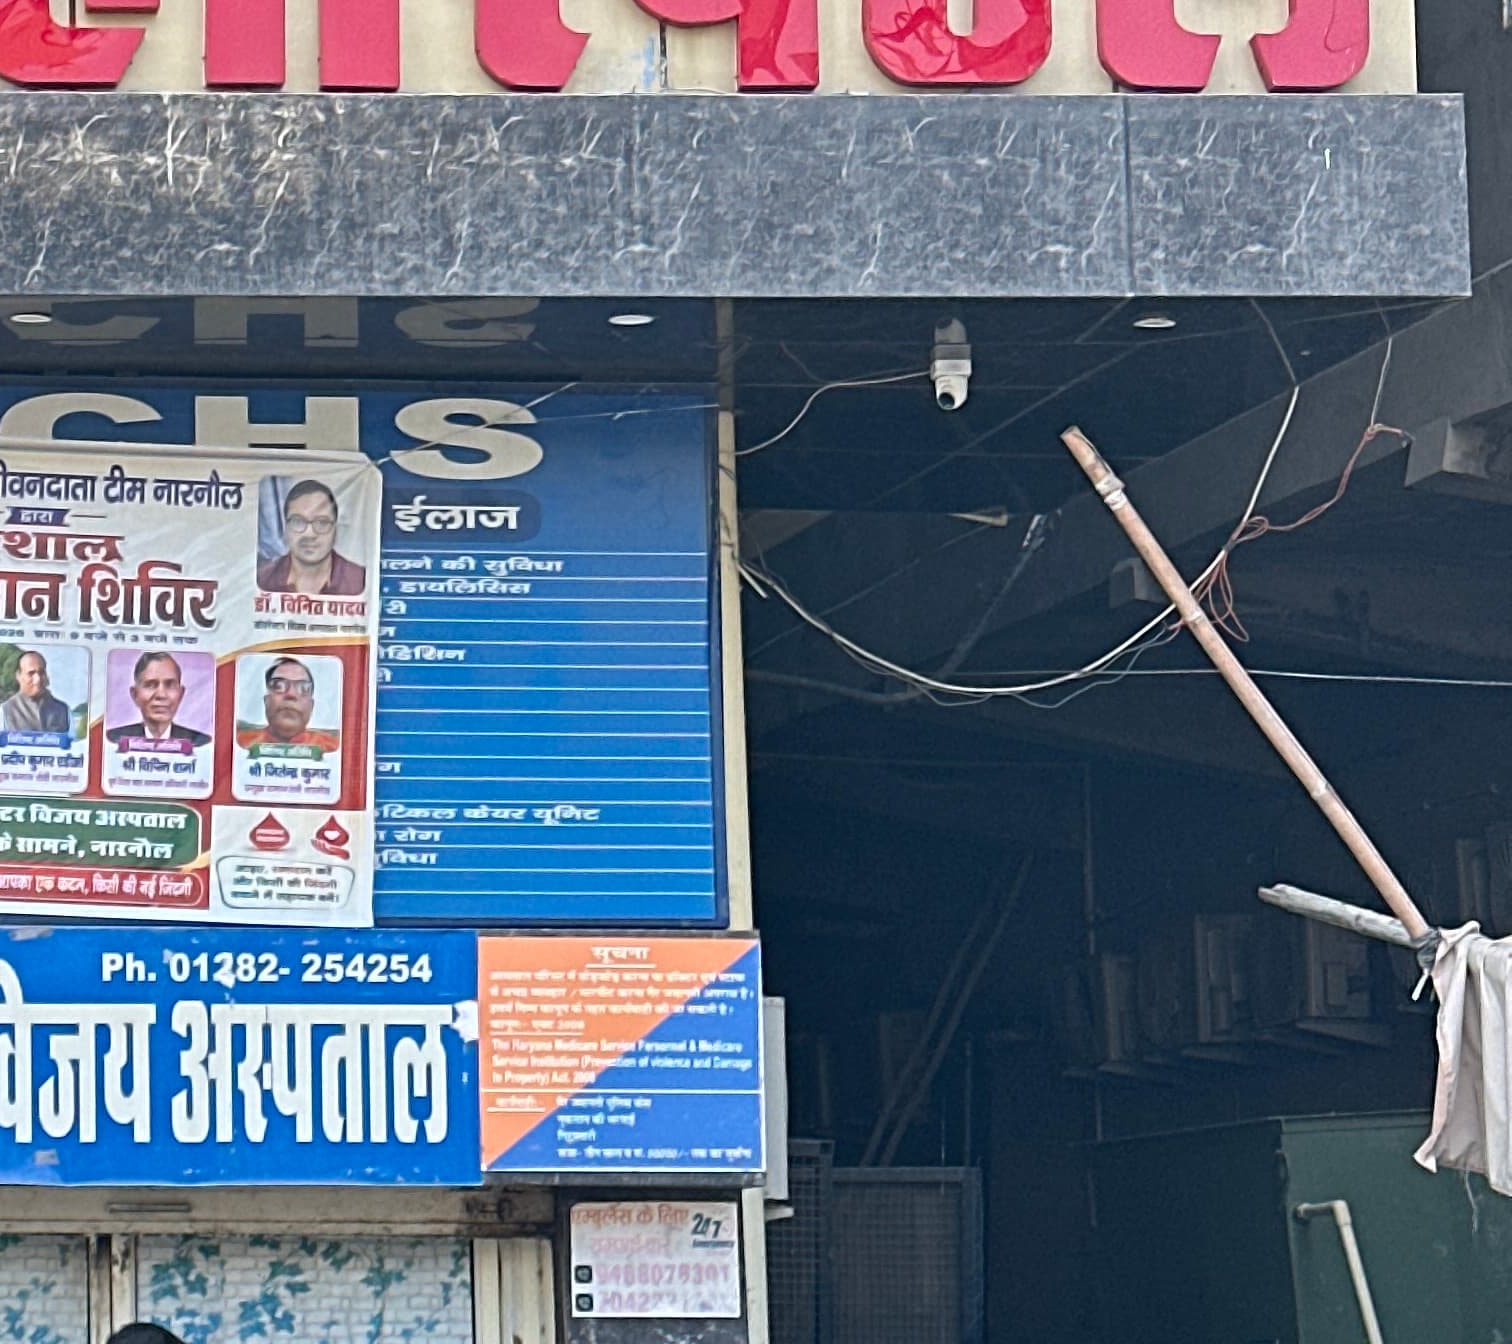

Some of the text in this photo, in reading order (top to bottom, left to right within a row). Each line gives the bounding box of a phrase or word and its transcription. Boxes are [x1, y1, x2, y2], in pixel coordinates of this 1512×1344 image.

[103, 464, 147, 504] टीम
[153, 469, 245, 509] नारनौल
[392, 495, 521, 533] ईलाज
[441, 556, 477, 571] की
[483, 556, 564, 577] सुविधा
[77, 560, 219, 629] शिविर
[399, 579, 531, 595] डायलिसिस
[327, 600, 367, 617] यादव
[29, 803, 92, 825] विजय
[95, 809, 188, 829] अस्पताल
[533, 804, 601, 824] यूनिट
[394, 827, 442, 842] रोग
[122, 873, 137, 895] की
[101, 953, 158, 983] Ph.
[302, 954, 433, 984] 254254
[170, 999, 454, 1144] अस्पताल
